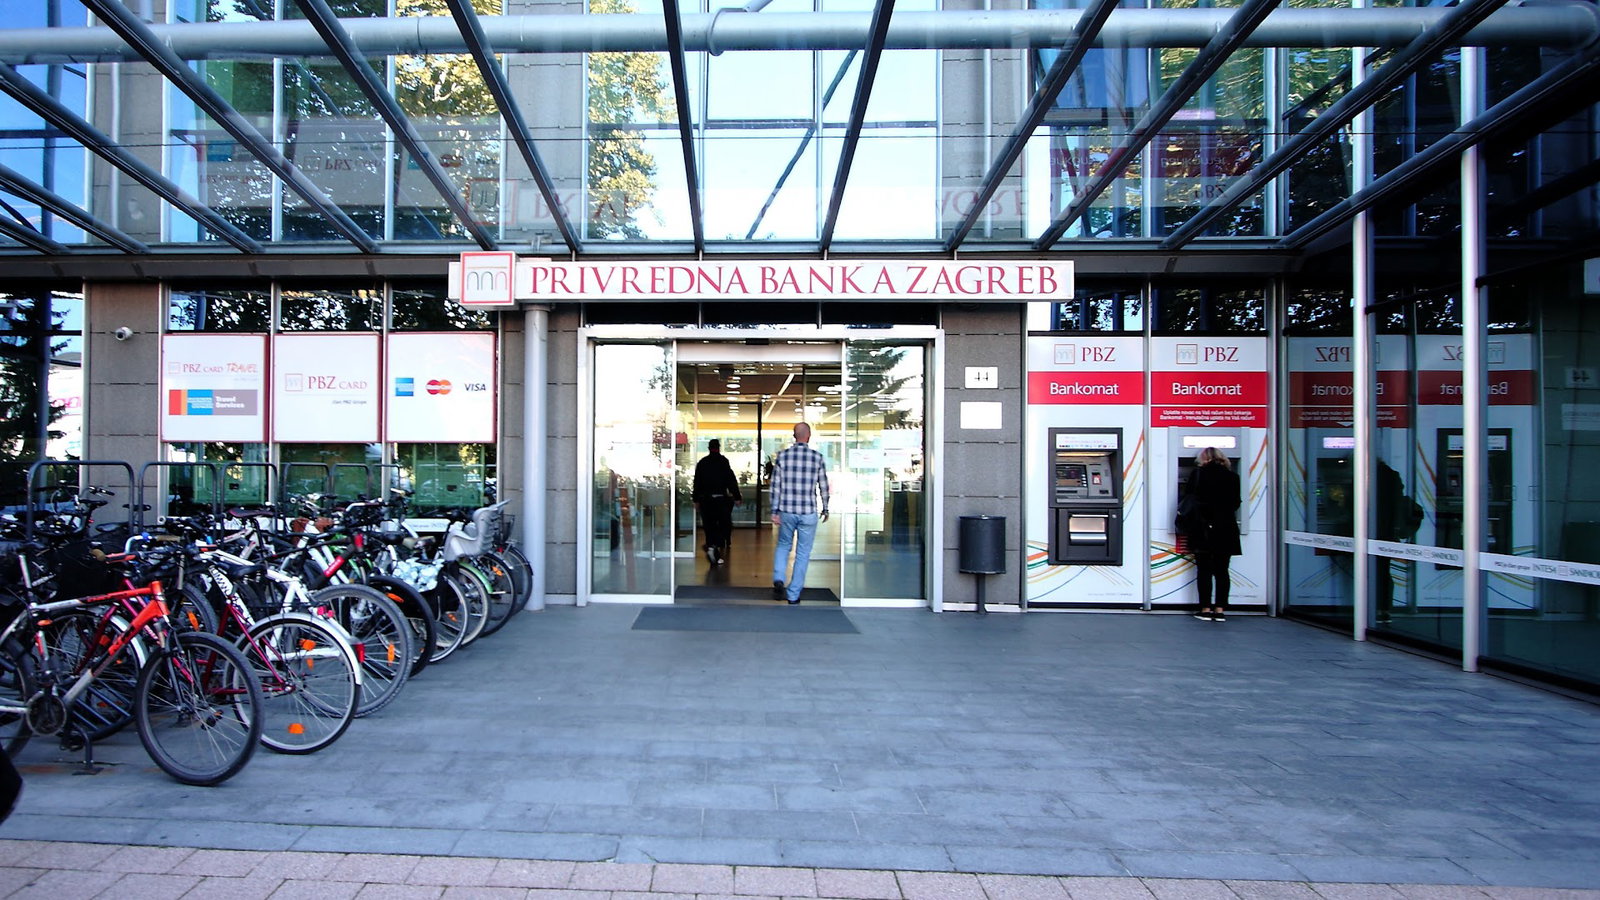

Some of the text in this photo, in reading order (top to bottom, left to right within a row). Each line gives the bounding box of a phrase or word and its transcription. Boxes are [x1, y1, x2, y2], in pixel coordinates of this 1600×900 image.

[530, 265, 1058, 294] PRIVREDNA BANKA ZAGREB
[1081, 346, 1116, 362] PBZ
[1204, 346, 1239, 362] PBZ
[183, 363, 201, 373] PBZ
[307, 375, 368, 390] PBZ CARD
[974, 371, 989, 382] 44
[464, 382, 487, 392] VISA
[1050, 382, 1119, 395] Bankomat
[1172, 382, 1242, 395] Bankomat
